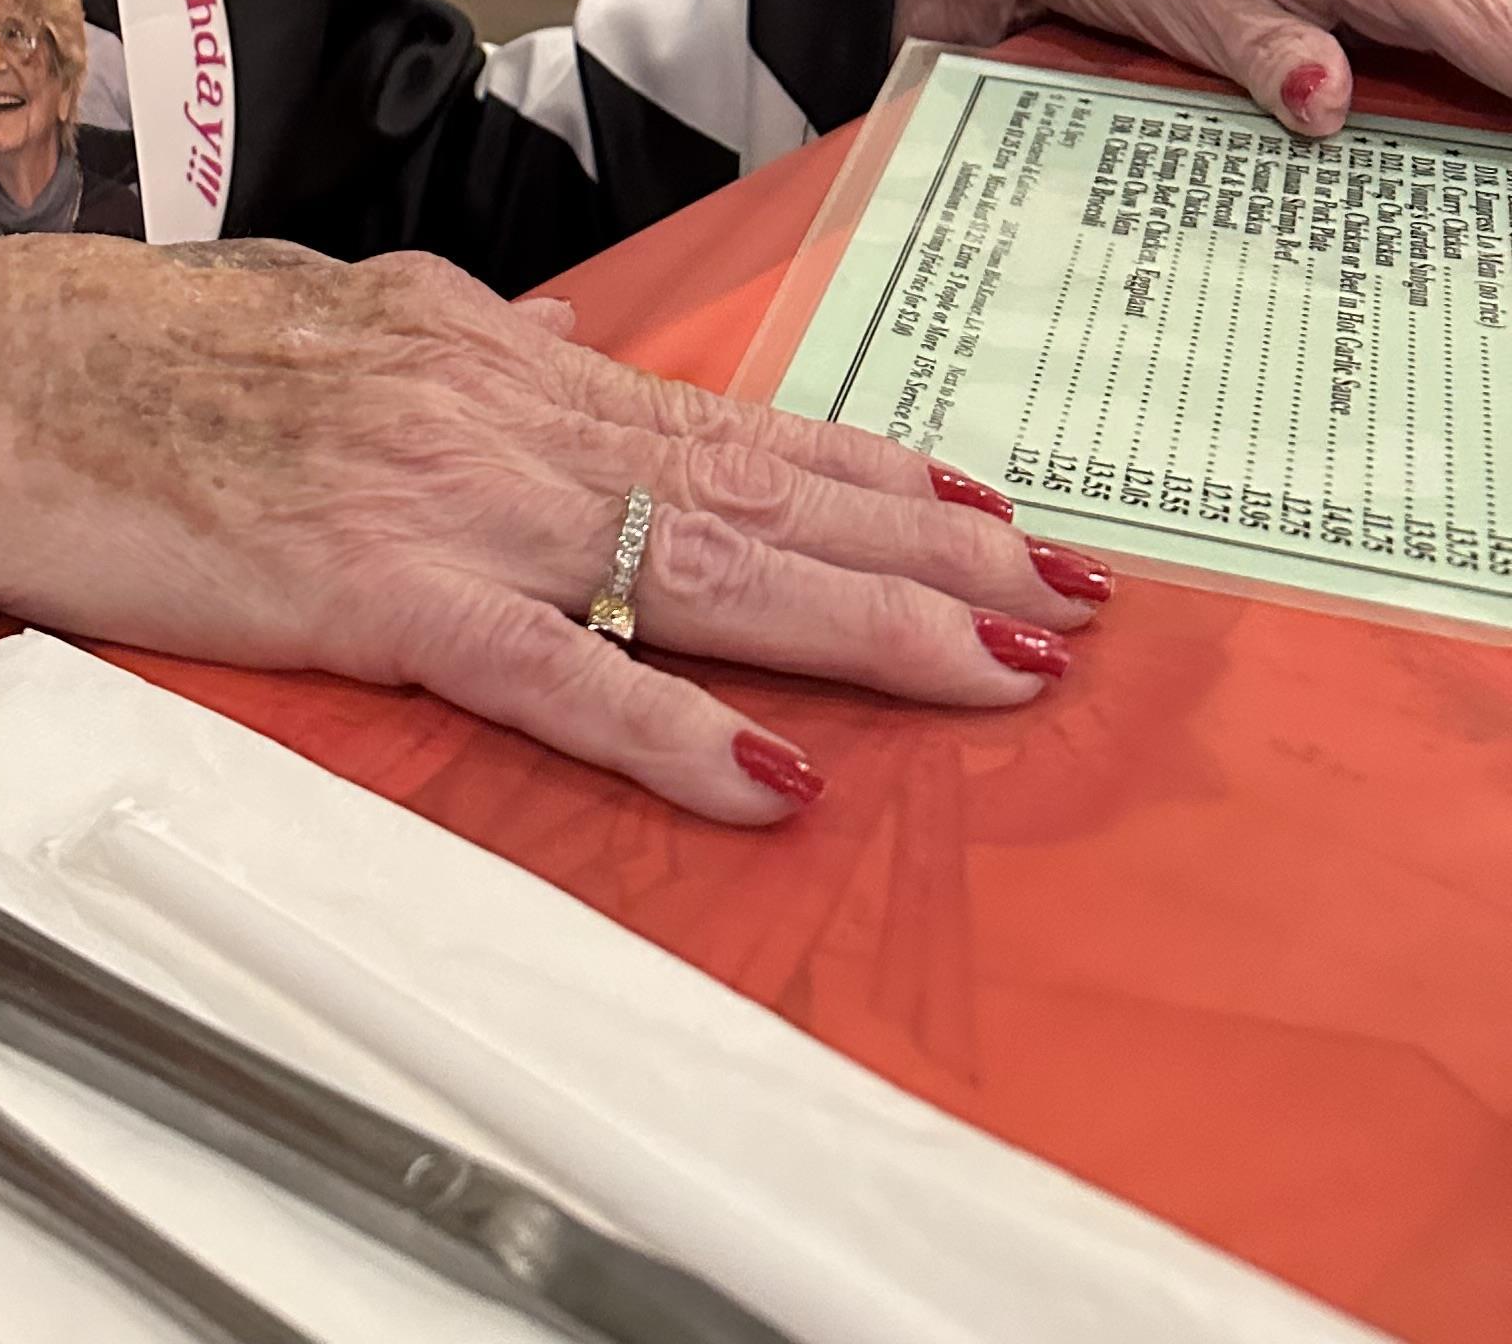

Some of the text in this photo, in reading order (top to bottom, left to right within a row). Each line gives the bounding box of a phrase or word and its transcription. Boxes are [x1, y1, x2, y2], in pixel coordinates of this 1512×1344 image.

[1096, 137, 1129, 175] Chicken
[1222, 154, 1248, 177] Beef
[1250, 158, 1278, 194] Sesame
[1379, 151, 1403, 175] D21.
[1474, 164, 1499, 188] D18.
[1093, 175, 1118, 186] &
[1151, 183, 1180, 208] Beef
[1220, 176, 1244, 188] &
[1080, 186, 1115, 228] Broccoli
[1148, 206, 1168, 219] or
[1211, 187, 1243, 230] Broccoli
[1243, 194, 1274, 236] Chicken
[1270, 195, 1306, 237] Shrimp,
[1376, 202, 1402, 224] Cho
[1468, 189, 1500, 234] Empress
[916, 248, 945, 275] fried
[953, 243, 981, 270] Extra
[1132, 220, 1171, 265] Chicken,
[1273, 238, 1301, 264] Beef
[1375, 225, 1402, 268] Chicken
[1476, 233, 1502, 249] Lo
[909, 273, 933, 292] rice
[1477, 250, 1504, 280] Mein
[901, 290, 928, 309] for
[1041, 118, 1164, 494] D29. Chicken Chow Mein 12.45
[1122, 267, 1161, 319] Eggplant
[1473, 280, 1505, 301] (no
[919, 271, 970, 352] 5 People or More
[1119, 126, 1223, 508] D27. General Chicken 12.05
[1474, 300, 1507, 330] rice)
[1278, 142, 1342, 539] D23. Rib or Pork Plate 12.75
[1319, 147, 1373, 547] D22. Shrimp, Chicken or Beef in Hot Garlic Sauce 14.95
[1401, 156, 1436, 563] D20. Young's Garden Subgum 13.95
[909, 354, 938, 379] 15%
[1437, 160, 1477, 571] D19. Curry Chicken 13.75
[893, 378, 929, 420] Service
[921, 396, 956, 431] Beauty
[1003, 445, 1041, 486] 12.45
[1080, 459, 1116, 501] 13.55
[1158, 472, 1194, 516] 13.55
[1198, 479, 1233, 523] 12.75
[1238, 487, 1273, 531] 13.95
[1360, 509, 1394, 554] 11.75
